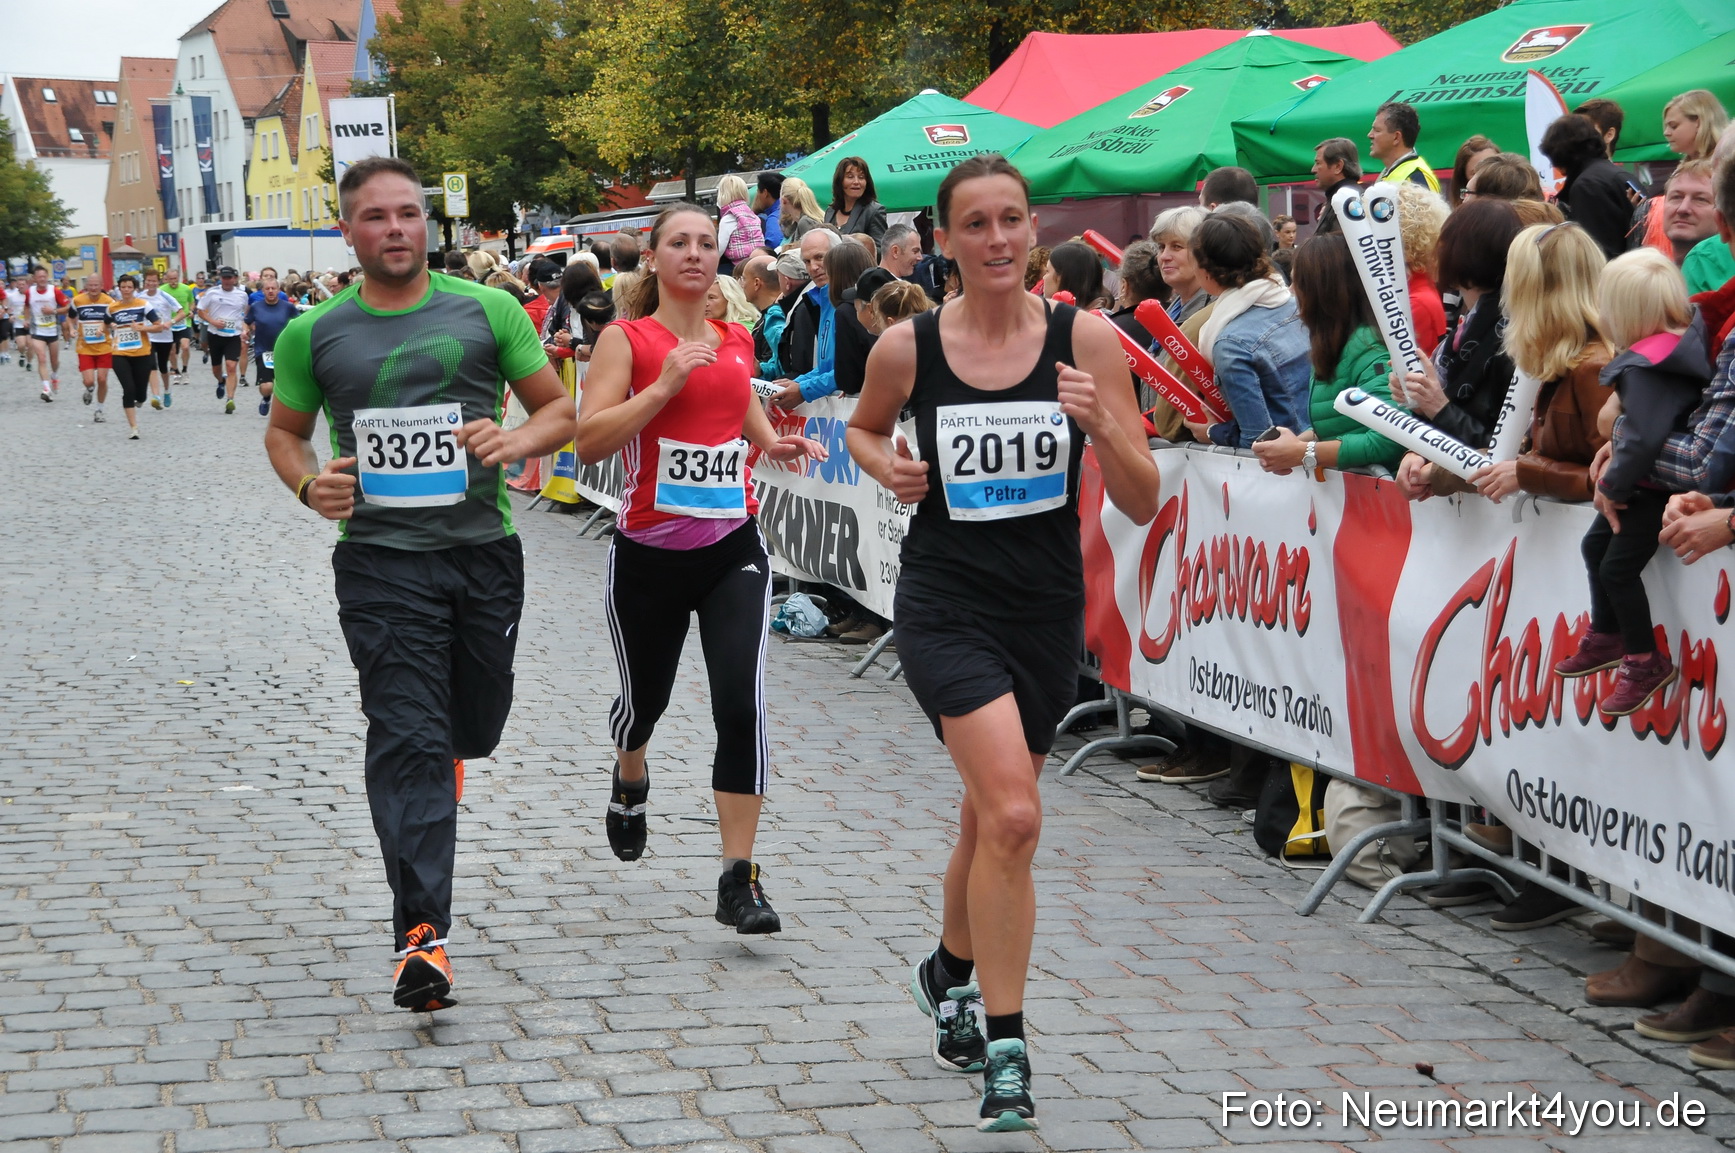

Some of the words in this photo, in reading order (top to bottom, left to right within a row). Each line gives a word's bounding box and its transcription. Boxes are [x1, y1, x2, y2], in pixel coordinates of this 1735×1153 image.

[1430, 67, 1590, 86] Neumarkter
[1384, 80, 1601, 104] Lammsbäu
[903, 148, 1001, 161] Neumarkte
[1143, 371, 1169, 395] BKK
[1190, 365, 1213, 390] BKK
[1166, 393, 1196, 418] Audi
[354, 419, 390, 429] PARTL
[391, 415, 444, 428] Neumarkt
[940, 416, 983, 429] PARTL
[985, 414, 1046, 427] Neumarkt
[367, 429, 455, 470] 3325
[951, 430, 1058, 477] 2019
[668, 448, 740, 483] 3344
[984, 485, 1027, 503] Petra
[1138, 478, 1318, 665] Charivari
[1189, 655, 1278, 720] Ostbayerns
[1281, 685, 1333, 738] Radio
[1506, 768, 1667, 865] Ostbayerns
[1676, 822, 1735, 897] Radi
